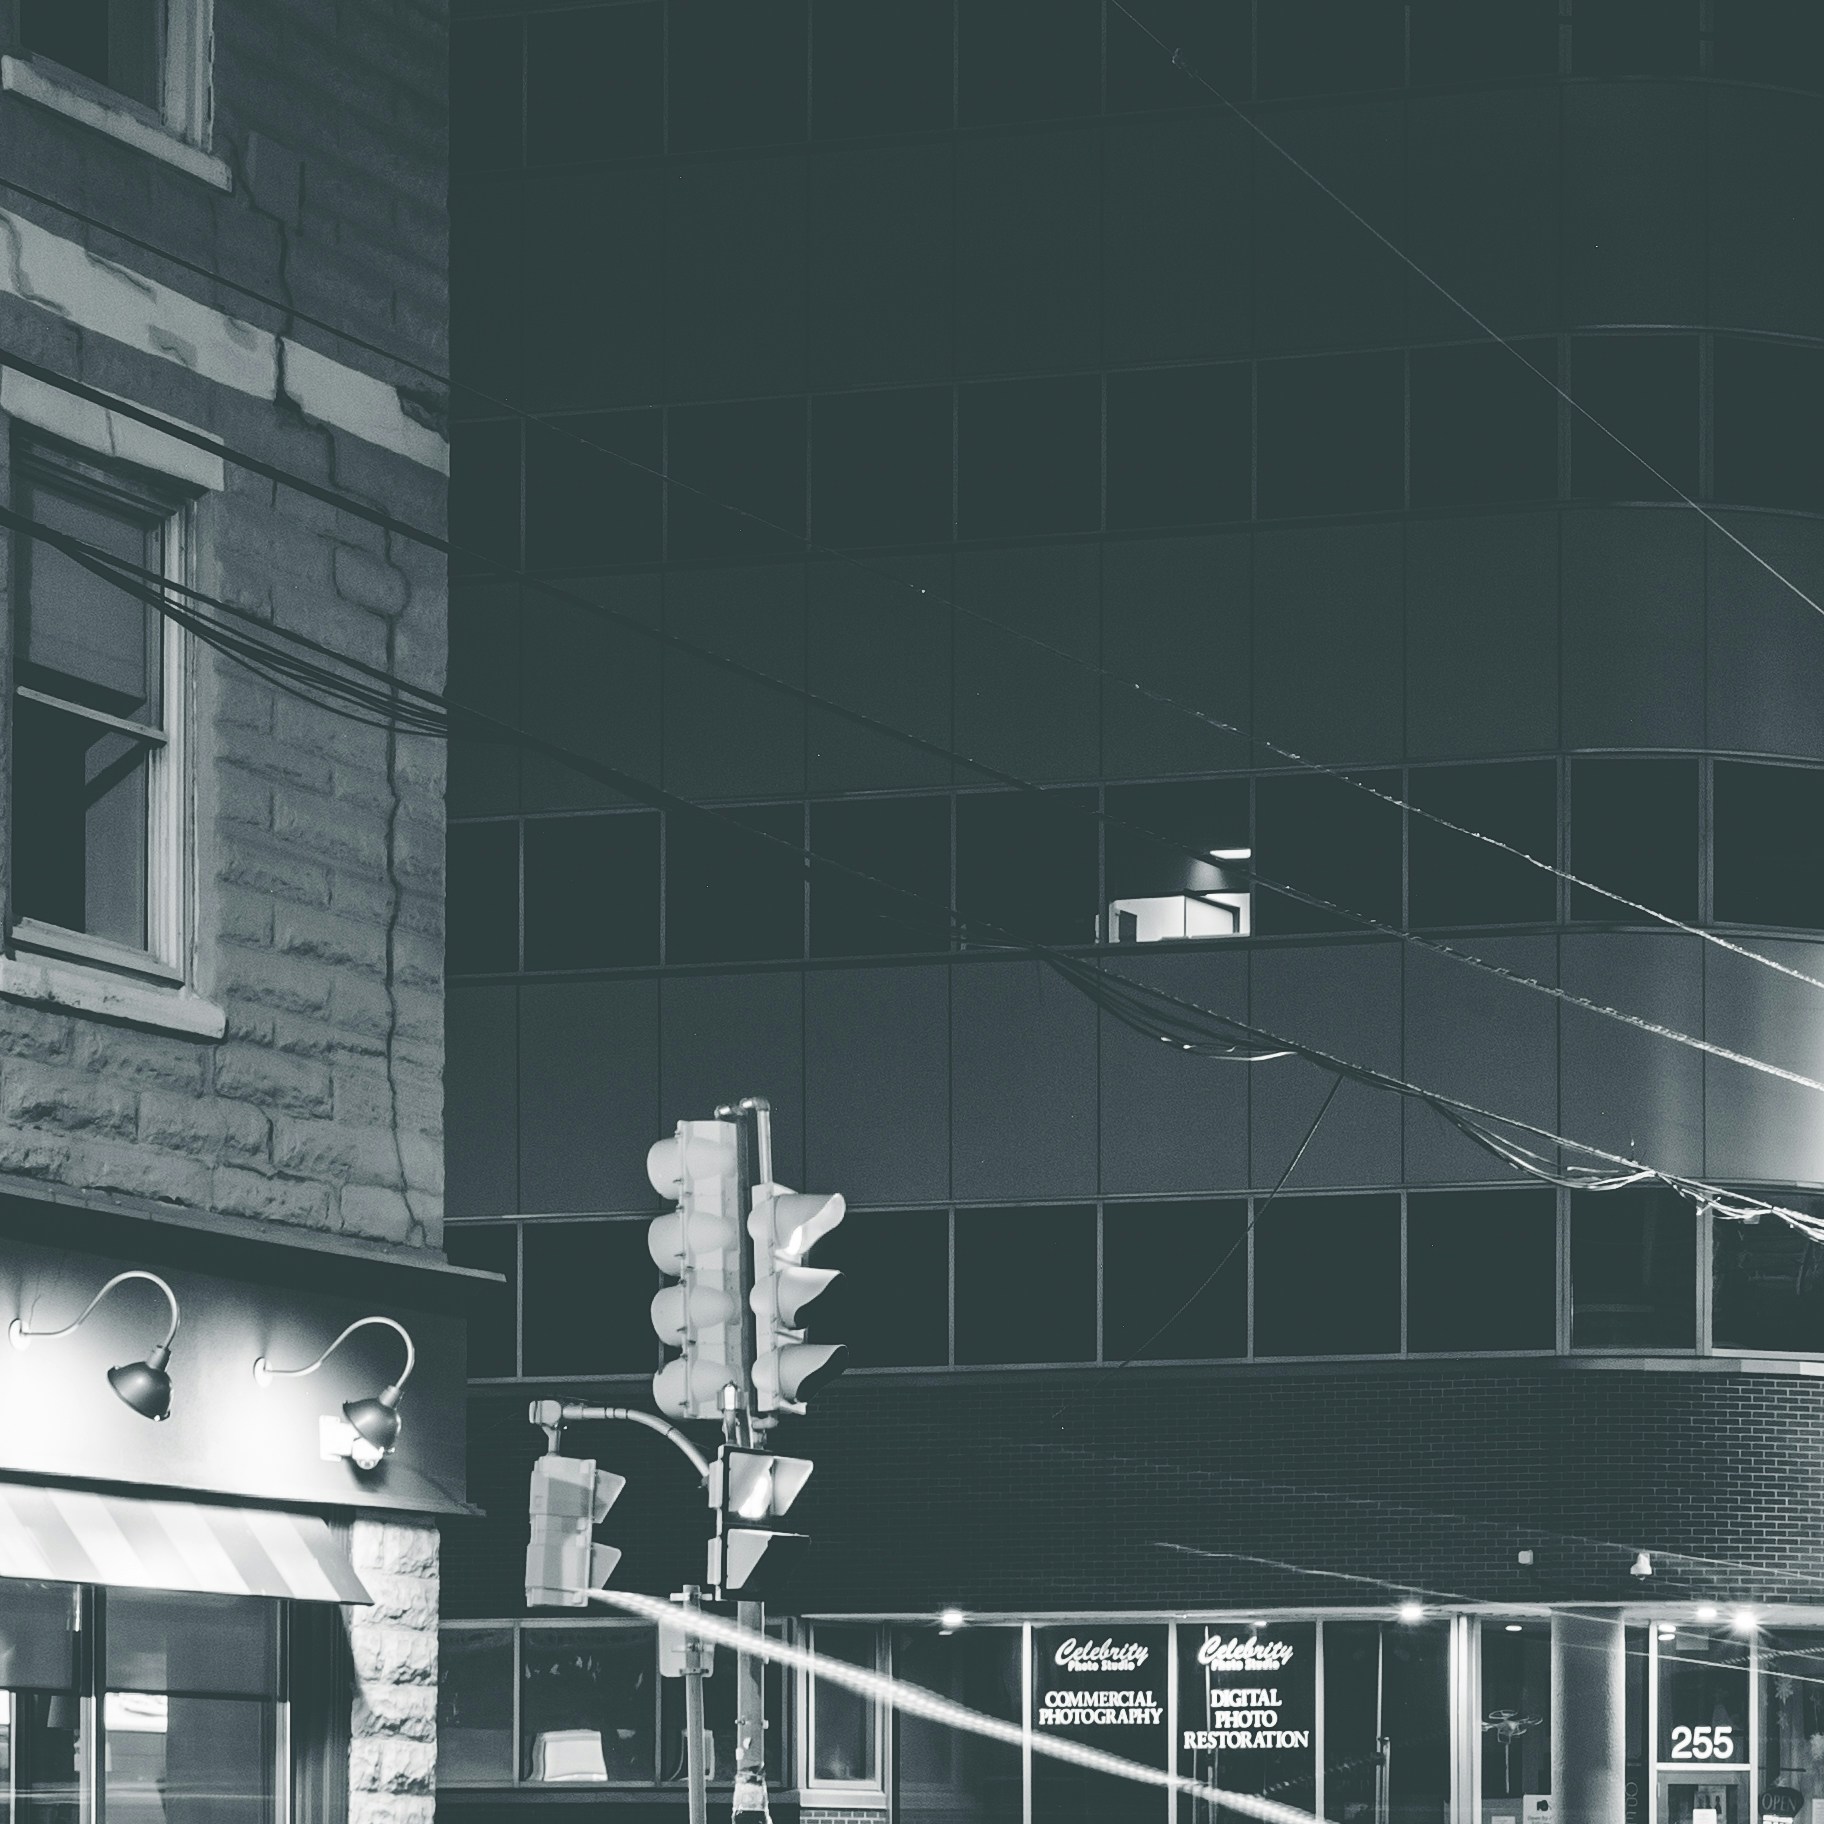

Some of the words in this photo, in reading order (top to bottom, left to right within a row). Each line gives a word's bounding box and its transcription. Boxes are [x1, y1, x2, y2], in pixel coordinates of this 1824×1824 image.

[1055, 1637, 1149, 1667] Celebrity
[1197, 1635, 1294, 1666] Celebrity
[1068, 1660, 1099, 1672] Photo
[1101, 1659, 1136, 1671] Studio
[1045, 1690, 1157, 1707] COMMERCIAL
[1211, 1688, 1283, 1707] DIGITAL
[1039, 1708, 1163, 1725] PHOTOGRAPHY
[1215, 1710, 1278, 1728] PHOTO
[1183, 1731, 1310, 1749] RESTORATION
[1671, 1726, 1734, 1759] 255
[1761, 1793, 1796, 1811] OPEN
